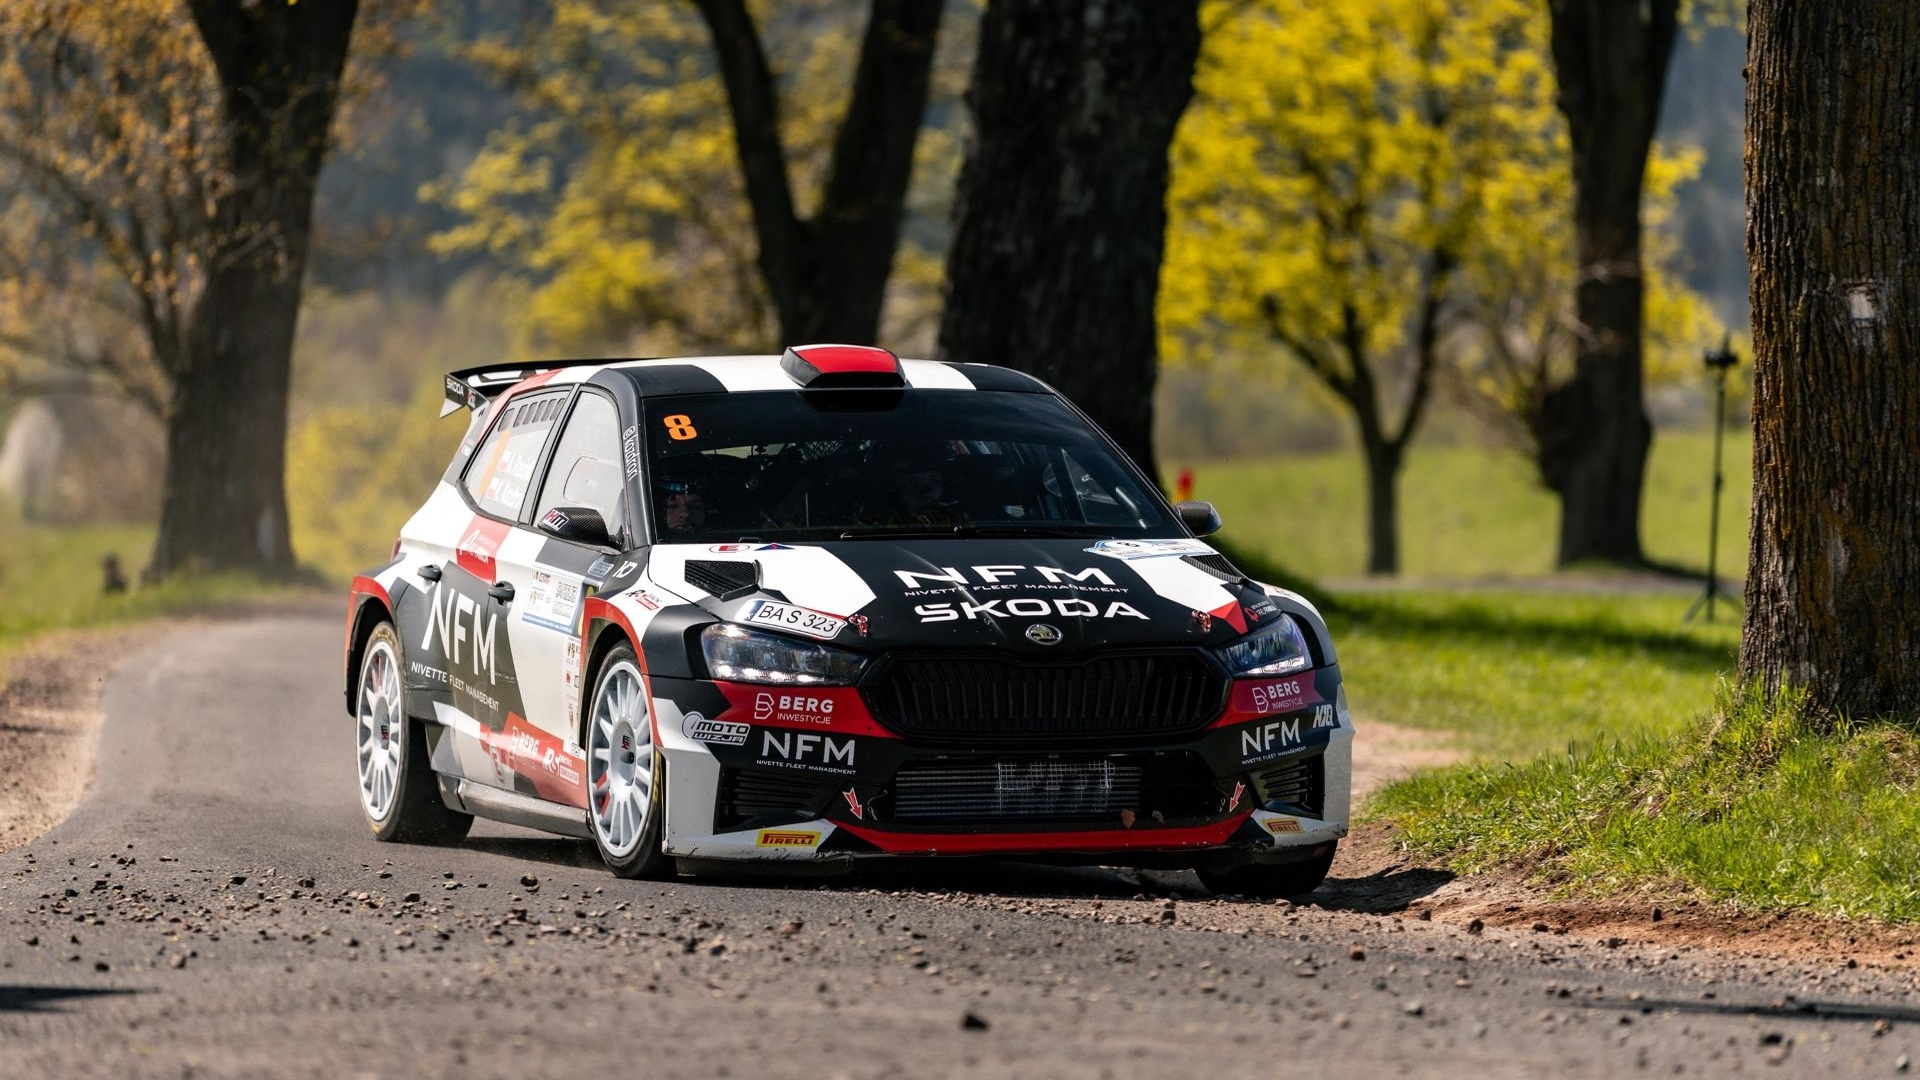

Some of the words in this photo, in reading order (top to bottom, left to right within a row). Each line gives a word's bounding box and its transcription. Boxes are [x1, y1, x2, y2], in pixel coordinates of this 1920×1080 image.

[663, 414, 698, 440] 8
[893, 565, 1116, 588] NFM
[904, 587, 968, 597] NIVETTE
[973, 584, 1018, 592] FLEET
[1025, 583, 1129, 593] MANAGEMENT
[758, 605, 784, 621] BA
[787, 611, 802, 624] S
[803, 614, 837, 632] 323
[914, 598, 1150, 623] SKODA
[421, 580, 497, 686] NFM
[411, 661, 448, 682] NIVETTE
[449, 675, 465, 691] FLEET
[465, 683, 499, 711] MANAGEMENT
[1267, 681, 1301, 699] BERG
[779, 695, 834, 713] BERG
[696, 721, 750, 734] MOTO
[776, 712, 831, 724] INWESTYCJE
[518, 731, 540, 758] BERG
[692, 732, 744, 743] WIZJA
[1242, 718, 1301, 756] NFM
[761, 730, 856, 766] NFM
[1242, 757, 1261, 765] NIVETTE
[1263, 752, 1277, 760] FLEET
[1278, 745, 1306, 756] MANAGEMENT
[756, 759, 784, 767] NIVETTE
[808, 765, 856, 775] MANAGEMENT
[1267, 820, 1301, 832] PIRELLI
[762, 834, 815, 844] PIRELLI
